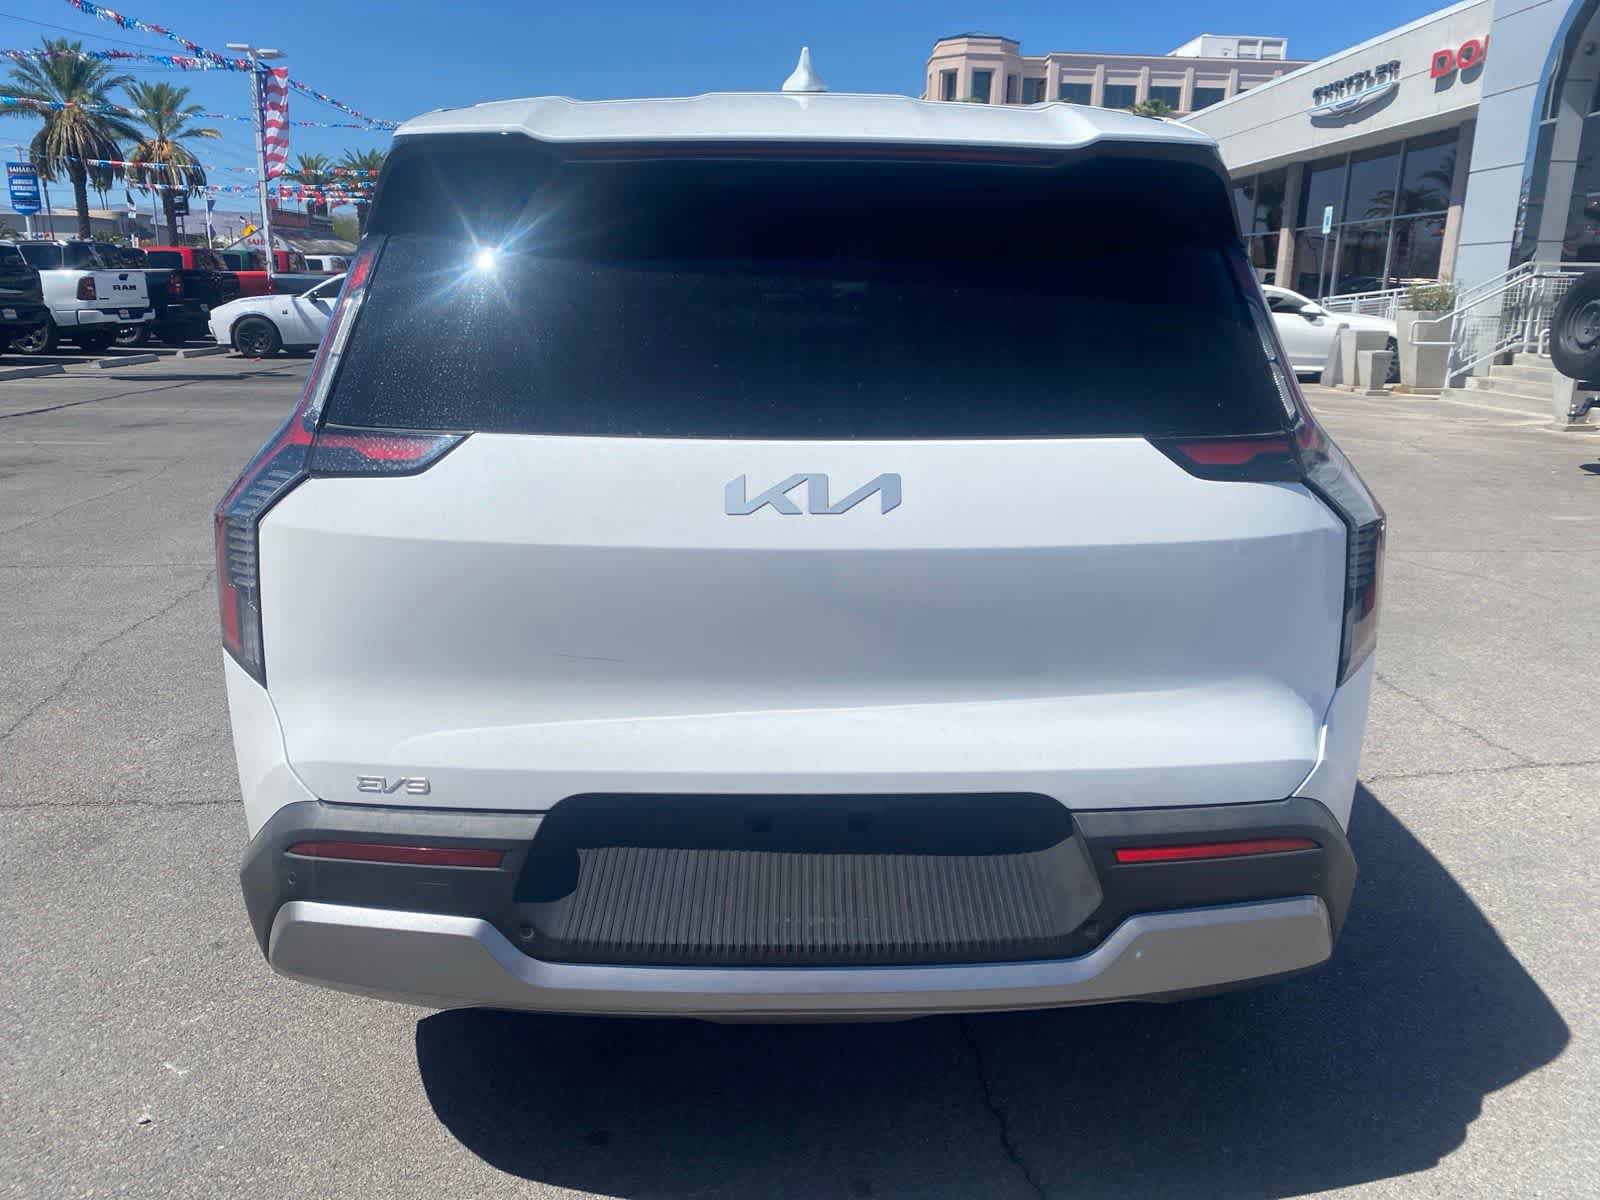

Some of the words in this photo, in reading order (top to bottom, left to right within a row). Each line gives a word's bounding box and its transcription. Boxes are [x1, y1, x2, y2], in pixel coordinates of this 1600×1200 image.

[1430, 35, 1489, 79] DO
[725, 473, 902, 515] KIA
[357, 775, 431, 795] EV9
